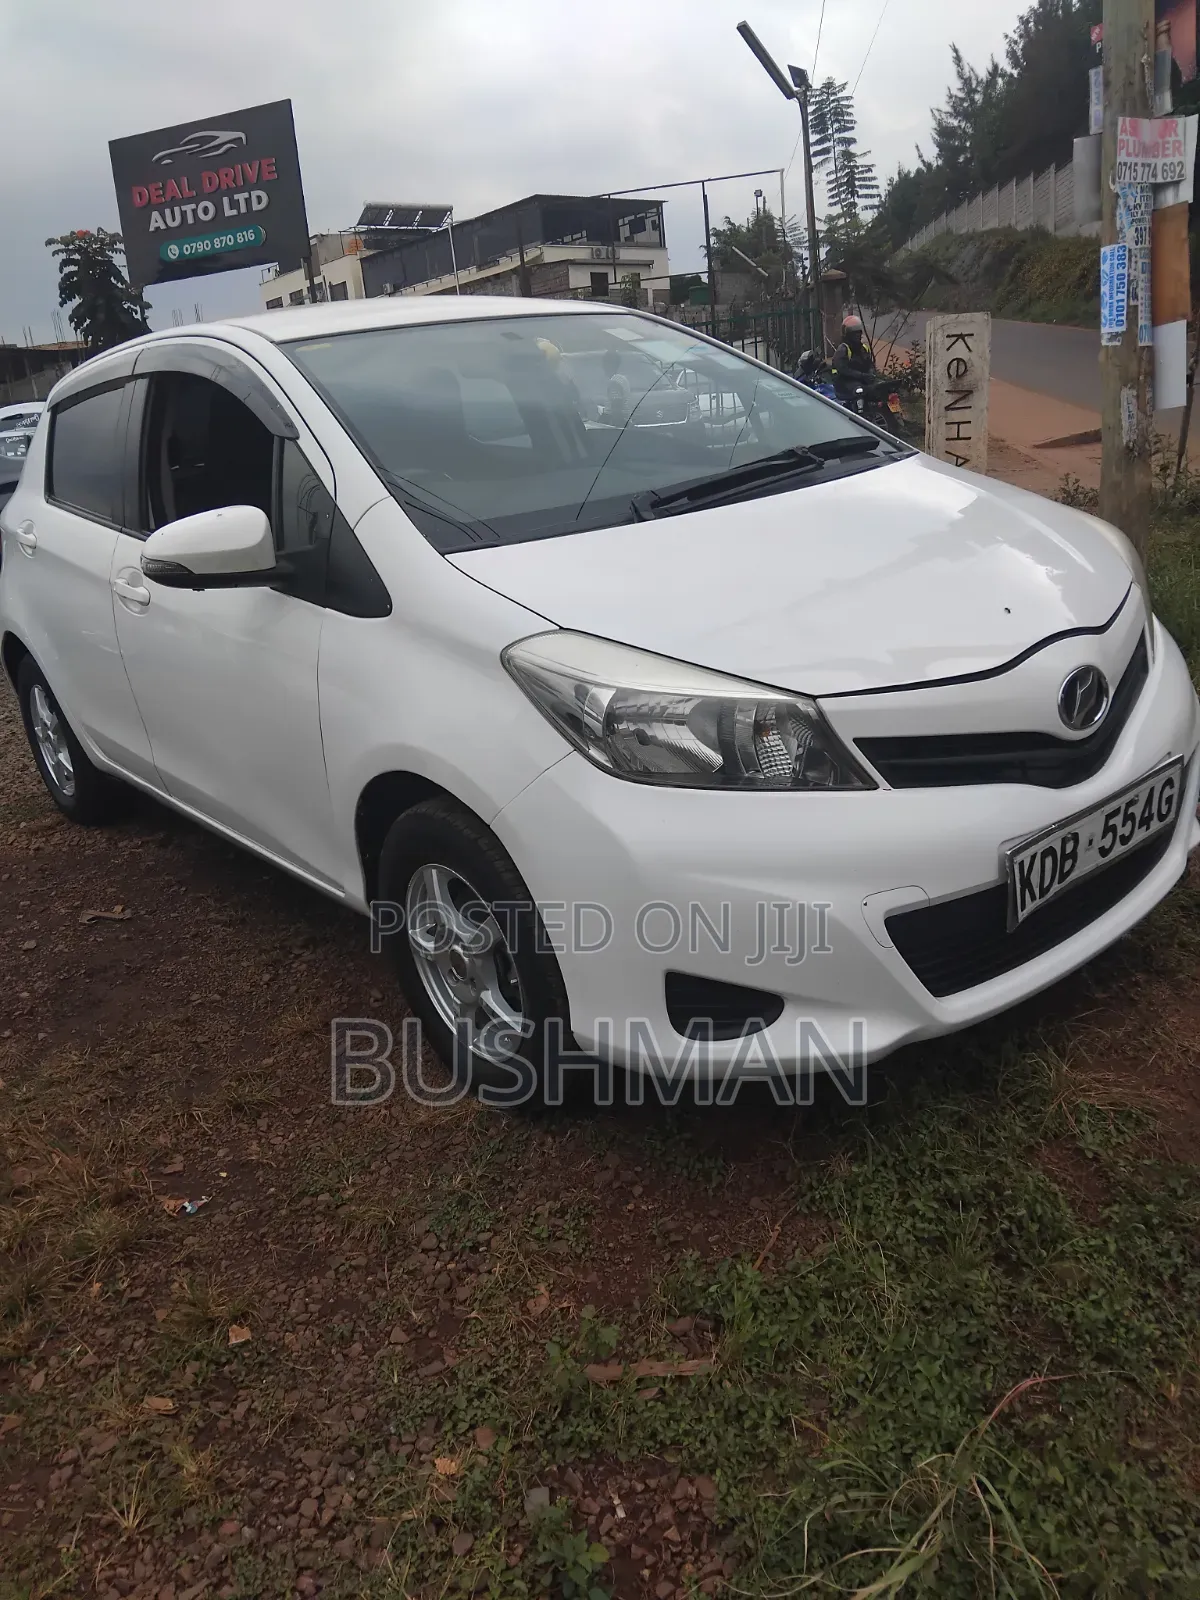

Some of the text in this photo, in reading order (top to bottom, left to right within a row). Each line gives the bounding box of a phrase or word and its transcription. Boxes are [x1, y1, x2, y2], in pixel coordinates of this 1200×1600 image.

[1117, 138, 1184, 159] PLUMBER
[132, 157, 278, 208] DEAL DRIVE
[1117, 160, 1185, 182] 0715 774 692
[149, 189, 270, 232] AUTO LTD
[183, 229, 256, 255] 0790 870 816
[1115, 245, 1127, 328] 0101 750 383
[1018, 776, 1175, 912] KDB 554G
